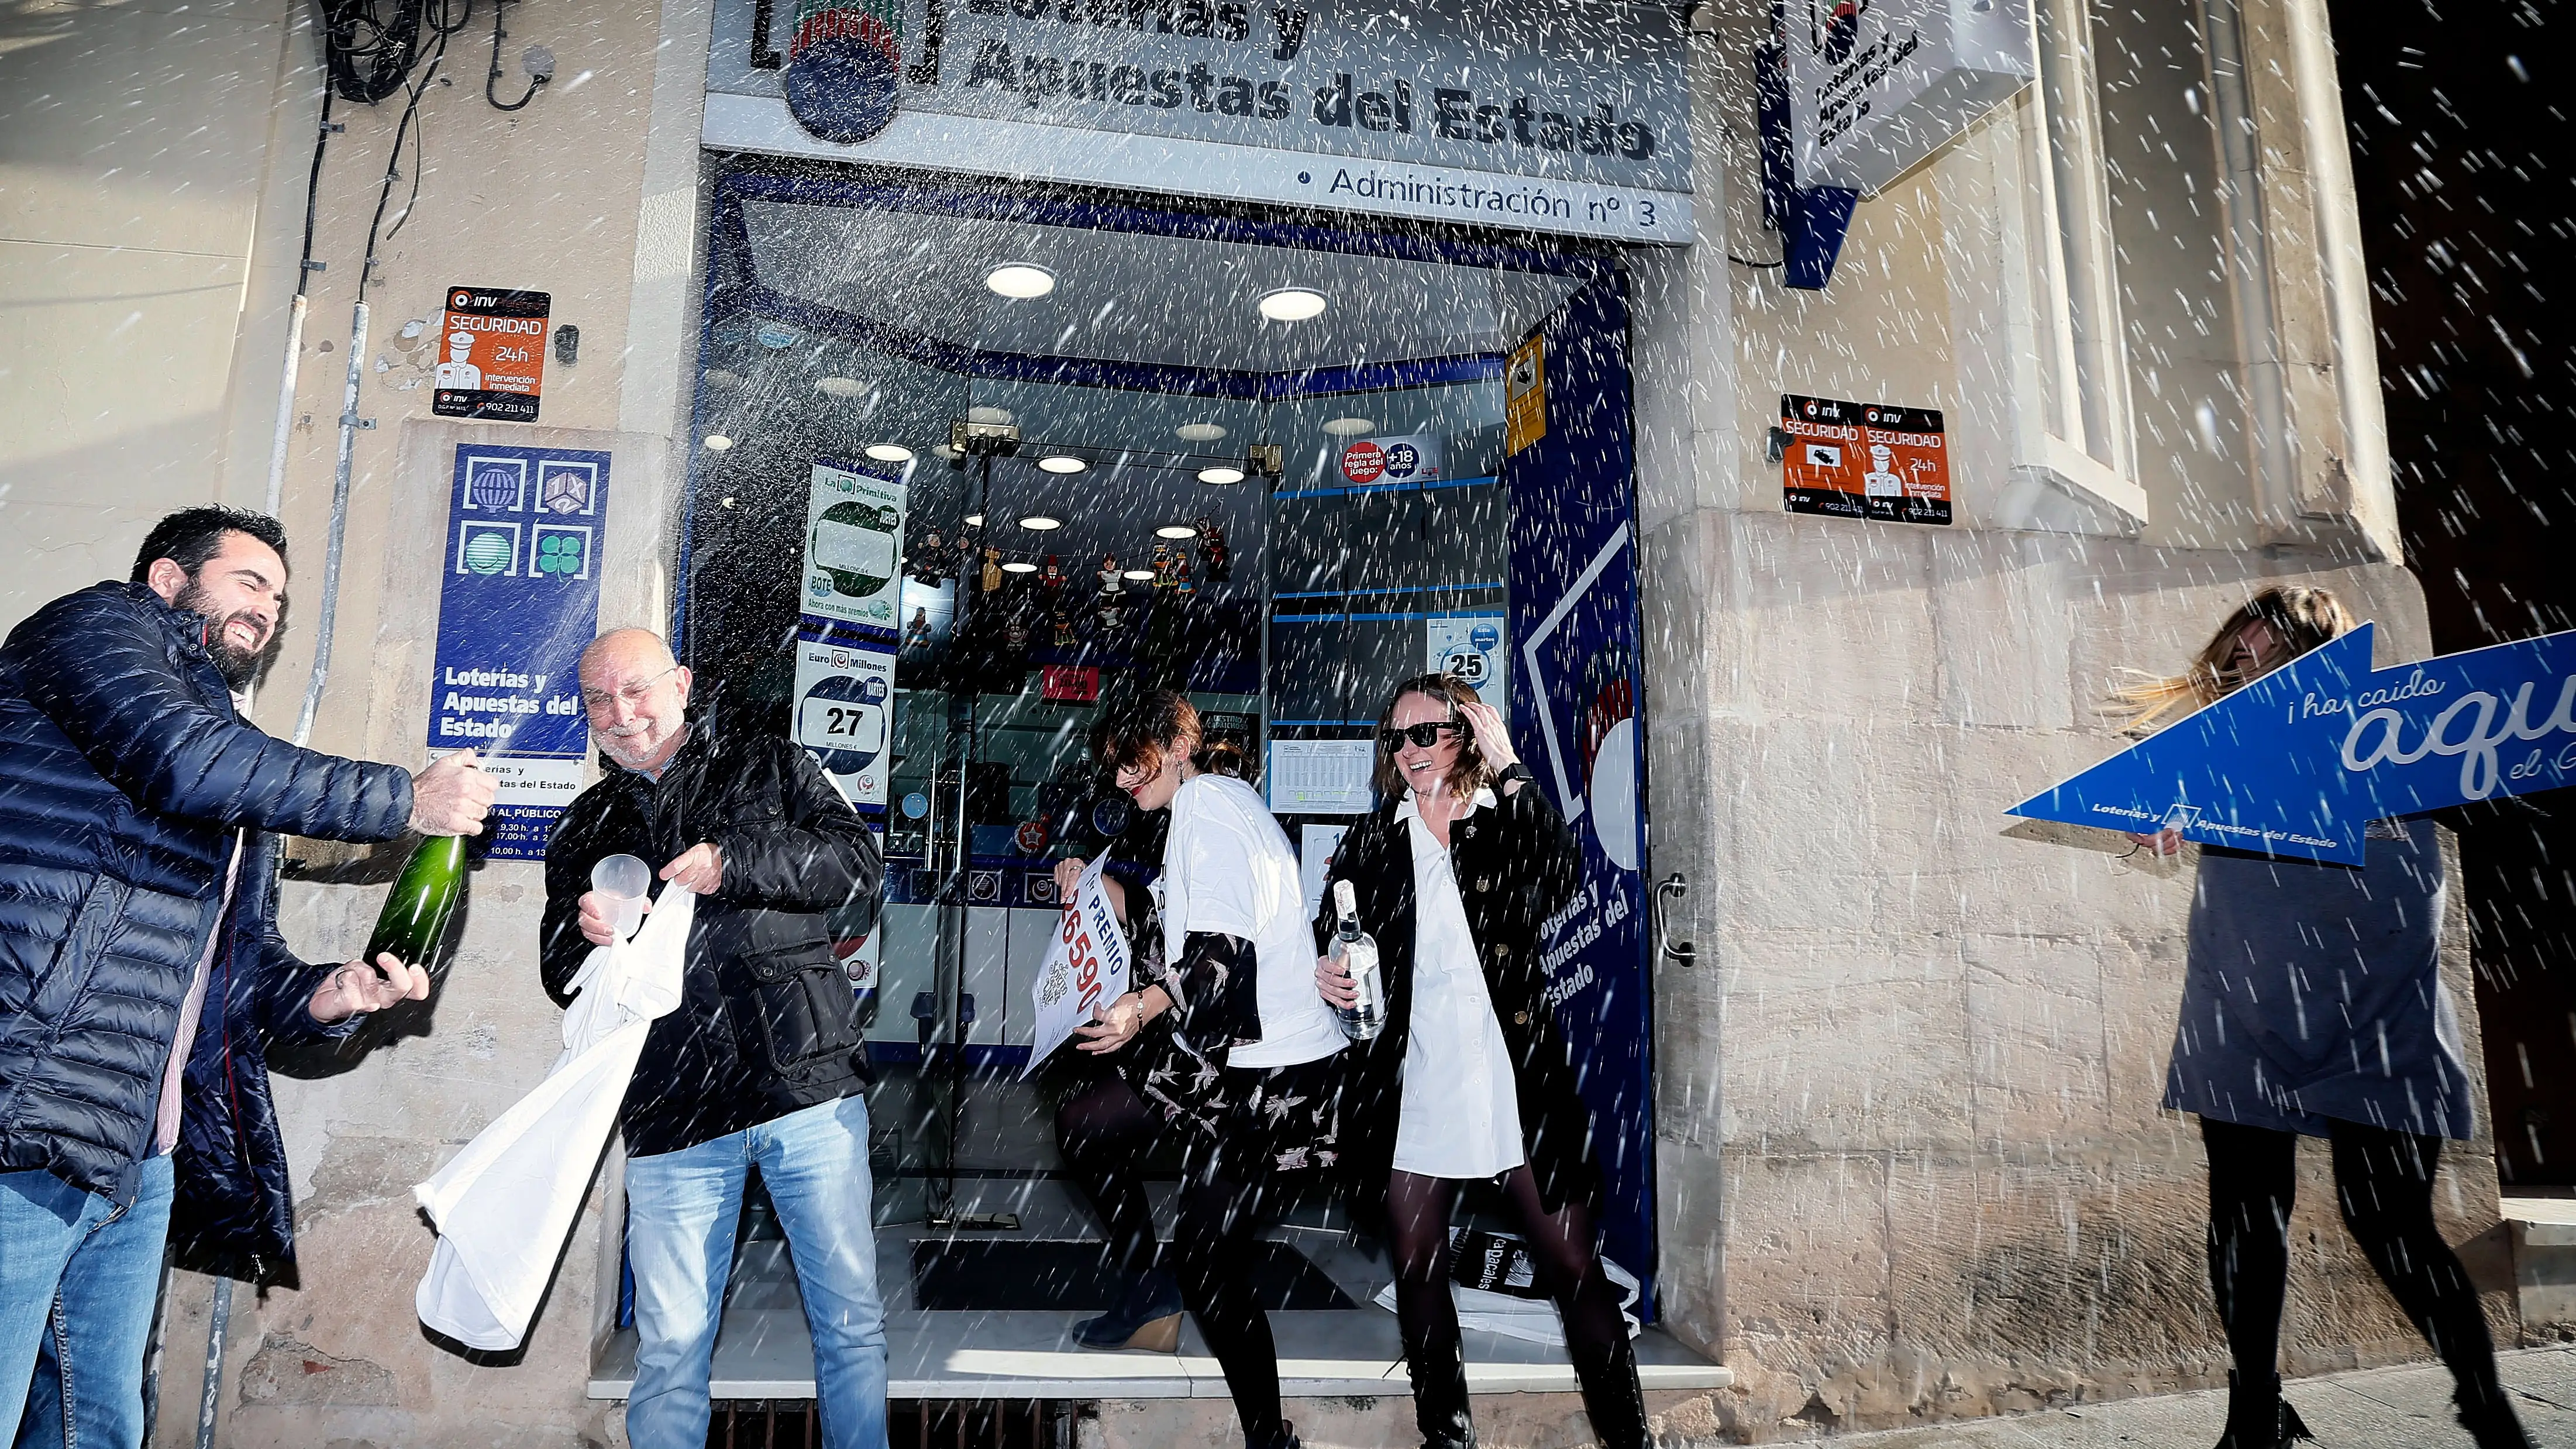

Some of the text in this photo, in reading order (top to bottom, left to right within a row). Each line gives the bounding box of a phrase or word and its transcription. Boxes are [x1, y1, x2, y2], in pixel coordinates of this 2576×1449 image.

[969, 0, 1310, 61] oterías y
[1892, 30, 1918, 66] del
[965, 39, 1655, 161] Apuestas del Estado
[1329, 168, 1572, 219] Administración
[1638, 201, 1656, 228] 3
[449, 315, 542, 335] SEGURIDAD
[495, 346, 528, 362] 24h
[485, 373, 536, 384] intervención
[489, 381, 530, 392] inmediata
[485, 402, 534, 414] 902 211 411
[1785, 421, 1859, 441] SEGURIDAD
[1868, 429, 1941, 448] SEGURIDAD
[1344, 457, 1384, 469] regla del
[1346, 451, 1382, 460] Primera
[1388, 450, 1414, 463] +18
[1909, 457, 1936, 472] 24h
[1349, 466, 1378, 477] juego:
[824, 477, 897, 502] La Primitiva
[1905, 482, 1945, 492] intervención
[1909, 490, 1942, 498] inmediata
[1825, 502, 1840, 511] 902
[1841, 504, 1851, 512] 211
[838, 563, 865, 574] MILLONES
[811, 576, 832, 593] BOTE
[808, 597, 869, 618] Ahora con más premios
[808, 652, 887, 672] Euro Millones
[1451, 654, 1482, 677] 25
[445, 666, 547, 694] Loterías y
[866, 682, 885, 698] MARTES
[443, 691, 579, 716] Apuestas del
[439, 717, 513, 739] Estado
[826, 707, 864, 736] 27
[826, 741, 853, 750] MILLONES
[485, 765, 525, 776] erías y
[2509, 748, 2543, 780] el
[519, 780, 536, 789] del
[540, 781, 576, 790] Estado
[498, 808, 512, 817] AL
[514, 807, 562, 819] PÚBLICO
[500, 824, 519, 832] 9,30
[2092, 803, 2339, 849] Loterías y Apuestas del Estado
[491, 847, 514, 855] 10,00
[1540, 879, 1599, 942] oterías y
[1088, 894, 1124, 976] PREMIO
[1538, 888, 1630, 979] Apuestas del
[1061, 888, 1103, 1015] 26590
[1478, 1238, 1507, 1290] capacales
